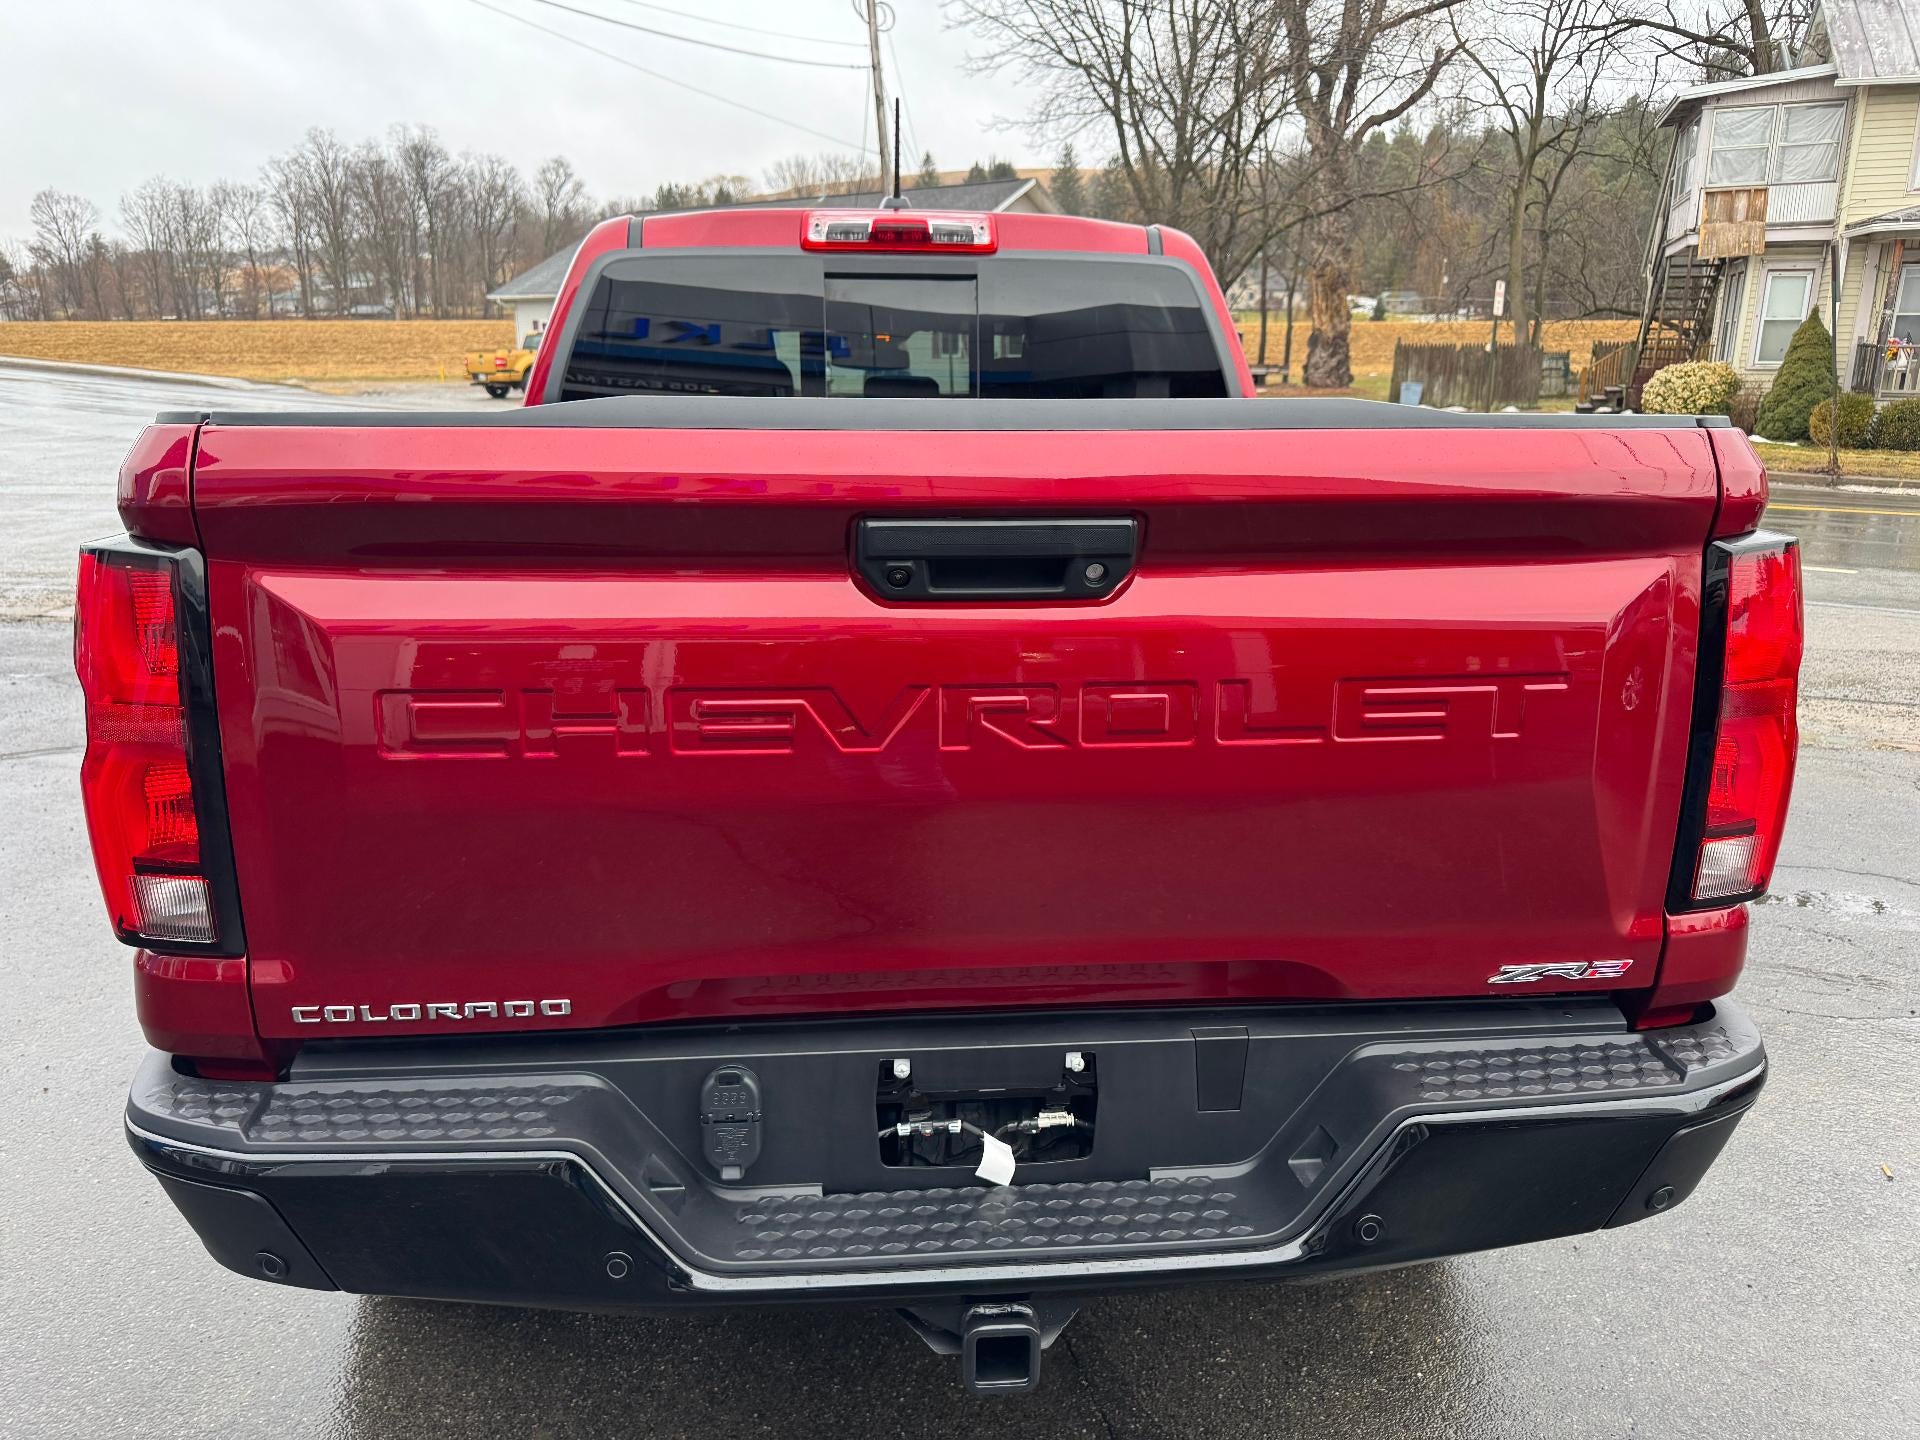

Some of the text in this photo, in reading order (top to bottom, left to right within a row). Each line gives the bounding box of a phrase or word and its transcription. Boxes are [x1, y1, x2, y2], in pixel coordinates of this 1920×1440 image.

[373, 672, 1572, 759] CHEVROLET
[1487, 959, 1634, 984] ZR2
[291, 998, 572, 1023] COLORADO
